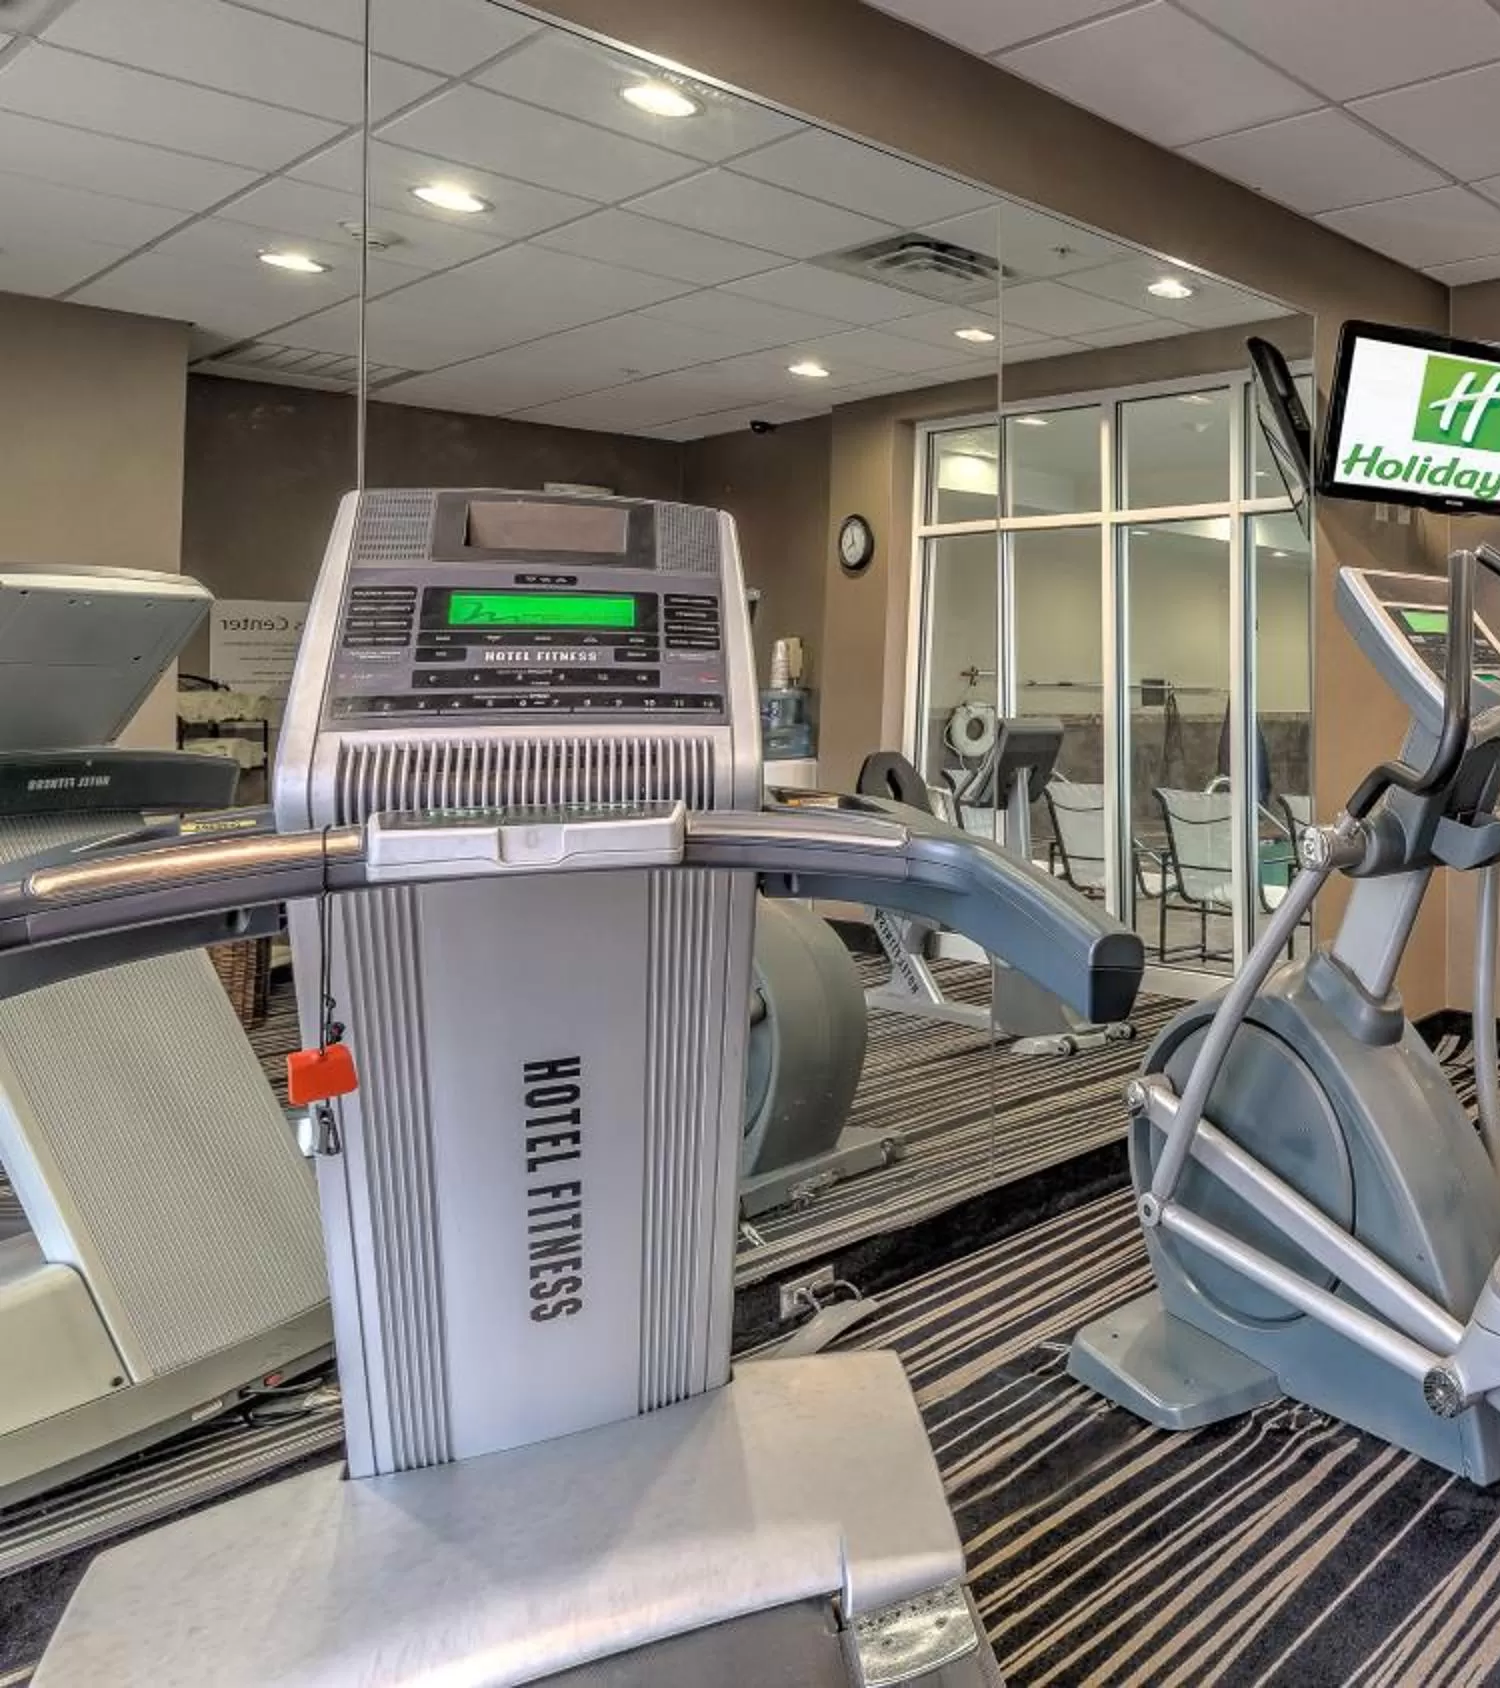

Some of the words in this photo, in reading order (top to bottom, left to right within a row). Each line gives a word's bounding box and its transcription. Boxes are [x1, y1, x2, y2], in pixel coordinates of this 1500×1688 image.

[484, 650, 530, 662] HOTEL
[536, 650, 598, 662] FITNESS
[523, 1055, 581, 1173] HOTEL
[527, 1180, 583, 1323] FITNESS
